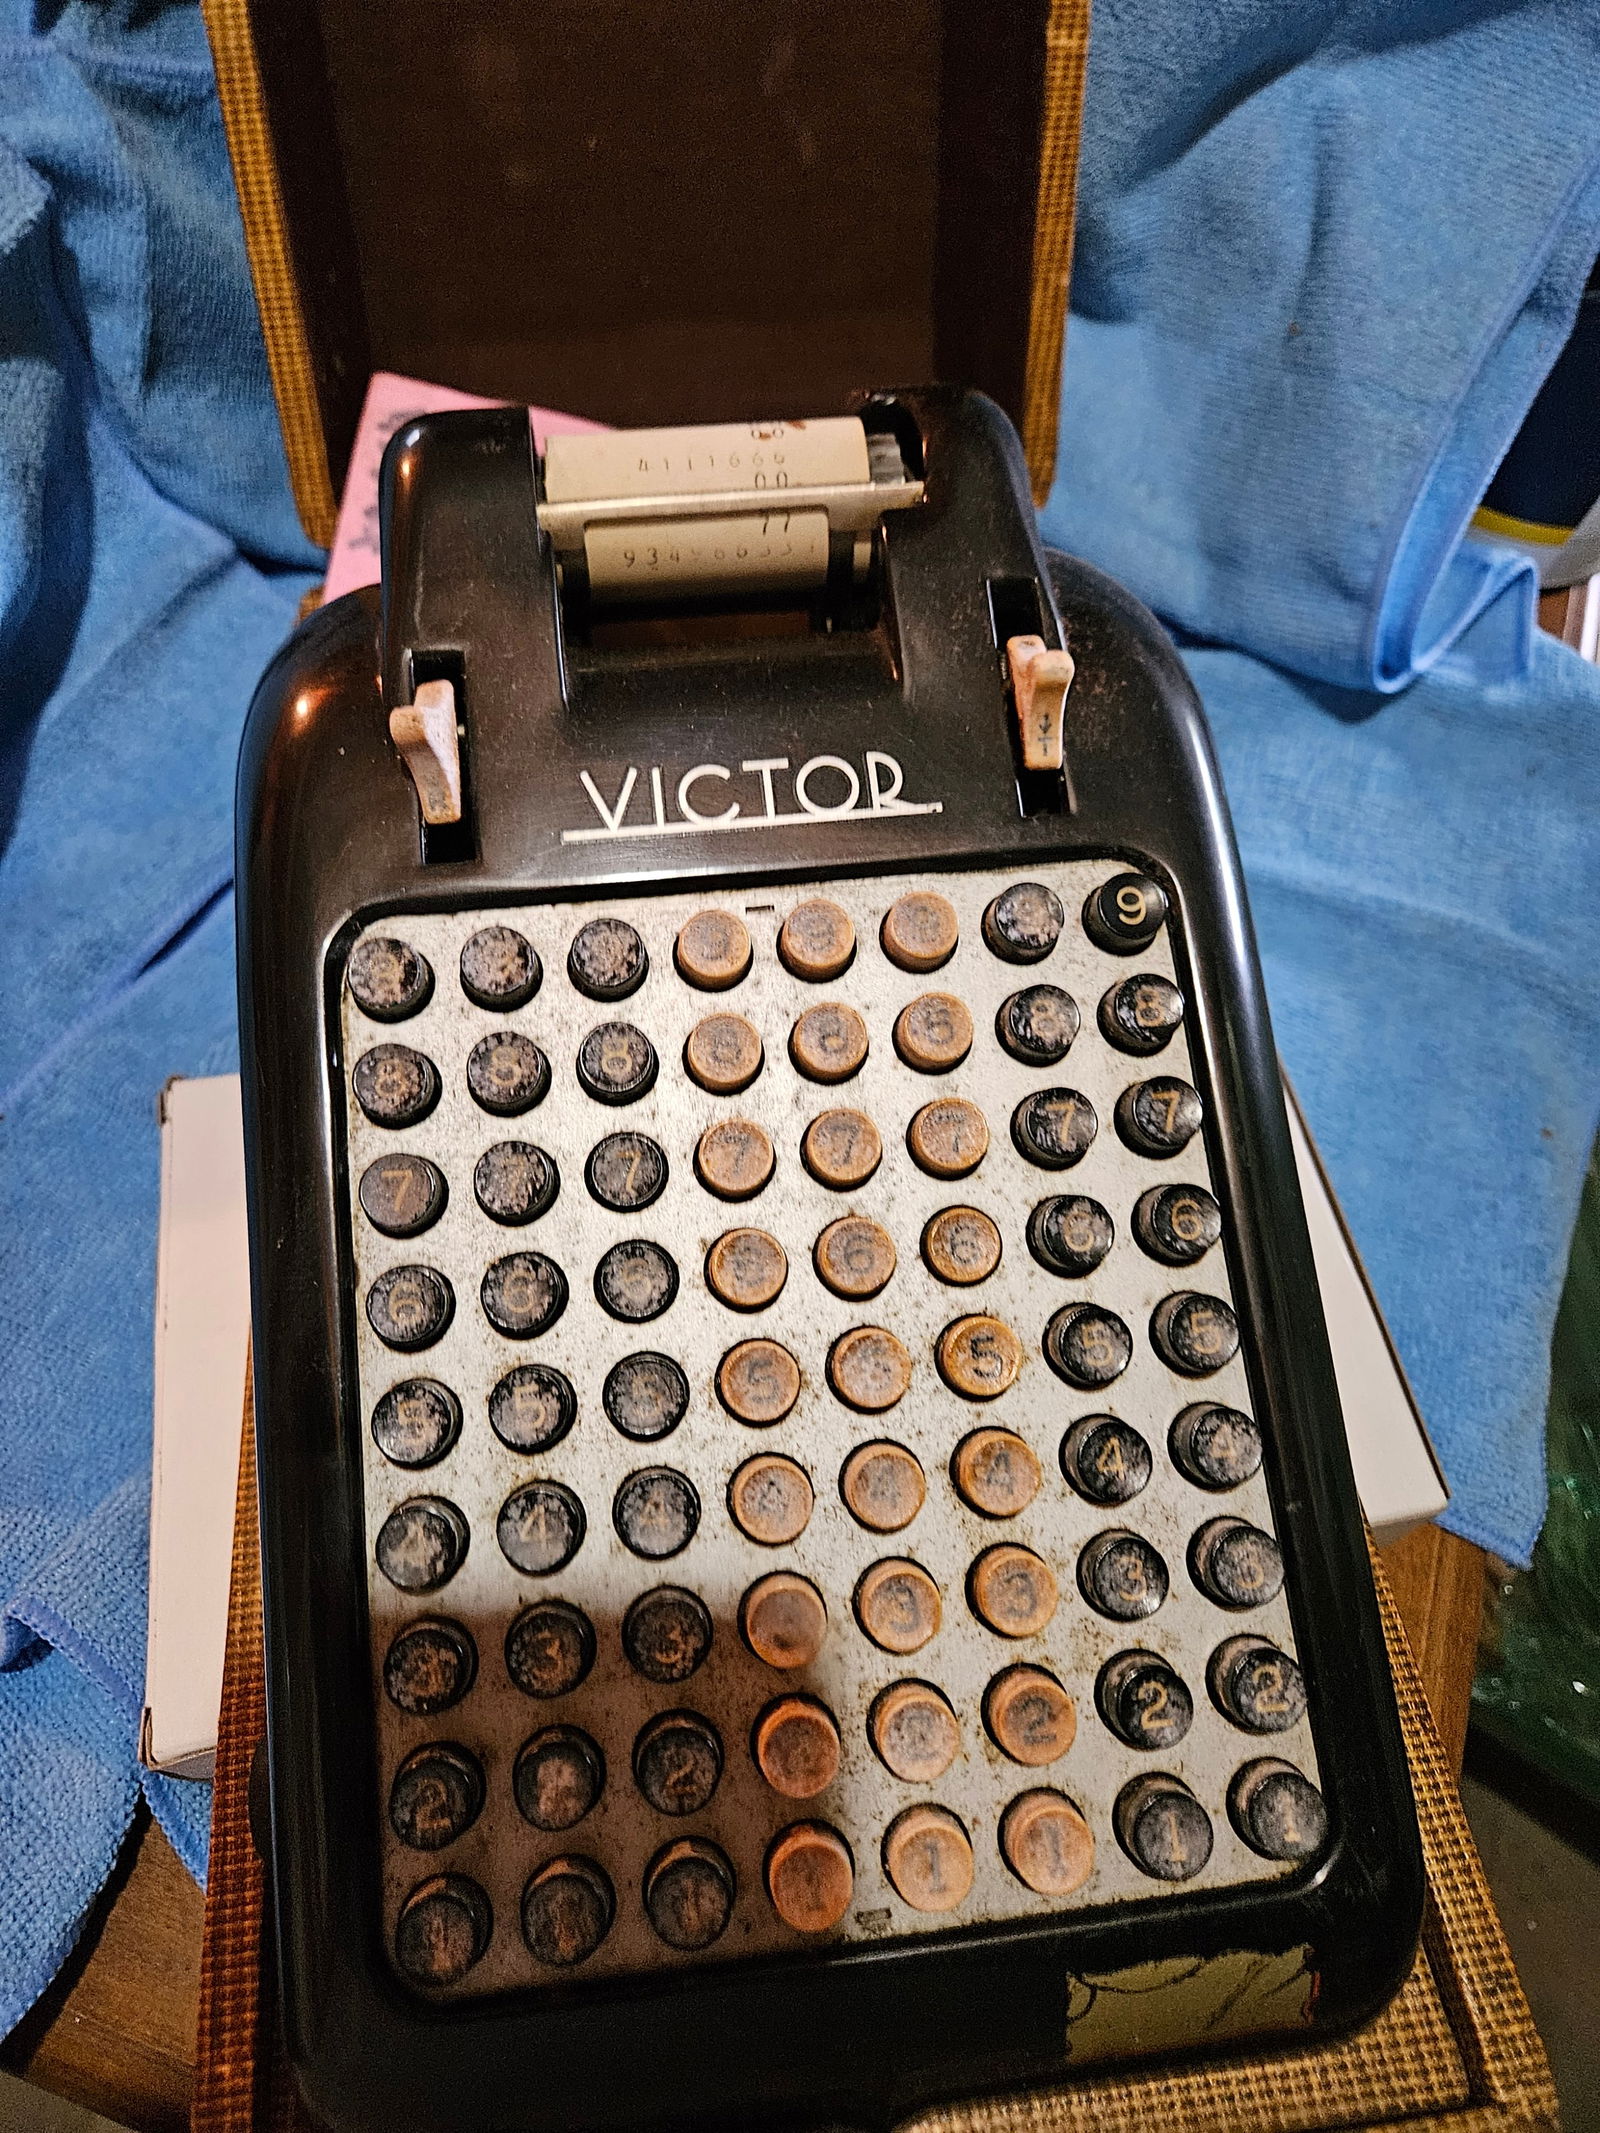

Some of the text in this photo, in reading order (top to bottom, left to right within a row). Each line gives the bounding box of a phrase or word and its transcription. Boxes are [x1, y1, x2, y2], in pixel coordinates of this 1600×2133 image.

[579, 751, 921, 832] VICTOR
[1116, 885, 1147, 926] 9
[1135, 987, 1165, 1028] 8
[489, 1046, 521, 1087] 8
[1046, 1101, 1076, 1144] 7
[1151, 1090, 1181, 1134] 7
[380, 1169, 414, 1212] 7
[615, 1150, 642, 1194] 7
[1063, 1211, 1095, 1252] 6
[1171, 1199, 1203, 1240] 6
[503, 1269, 534, 1314] 6
[1082, 1322, 1113, 1366] 5
[1191, 1311, 1222, 1355] 5
[969, 1334, 1004, 1379] 5
[514, 1384, 546, 1429] 5
[1096, 1437, 1126, 1481] 4
[520, 1504, 552, 1551] 4
[1115, 1555, 1147, 1601] 3
[1137, 1680, 1174, 1730] 2
[1253, 1664, 1290, 1713] 2
[1022, 1697, 1058, 1745] 2
[663, 1748, 697, 1795] 2
[415, 1778, 452, 1828] 2
[1279, 1791, 1302, 1843] 1
[1166, 1809, 1187, 1862] 1
[923, 1843, 949, 1894] 1
